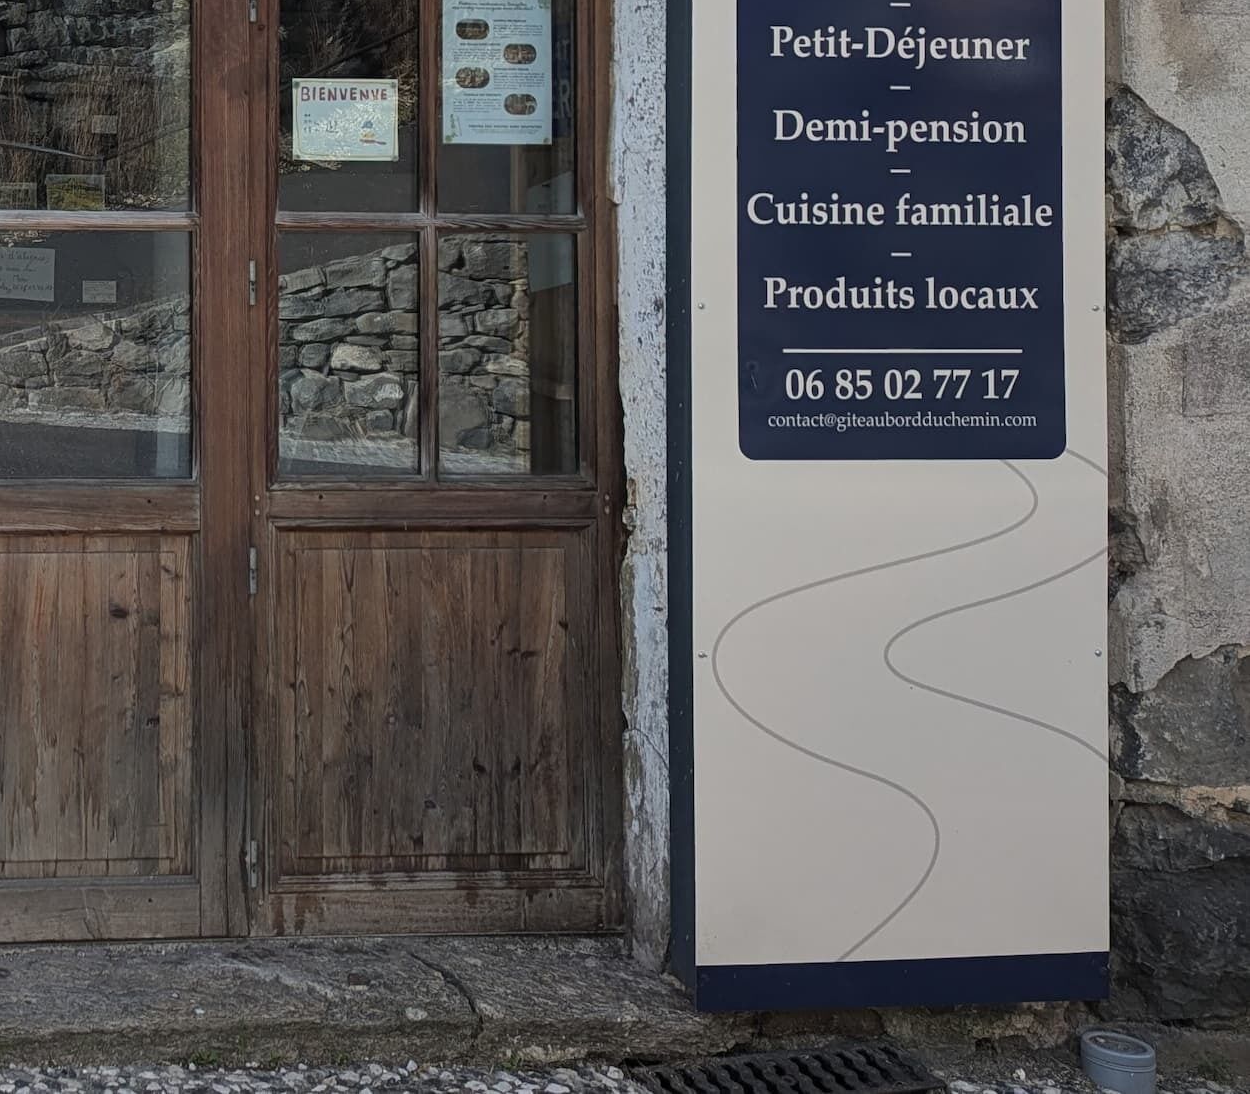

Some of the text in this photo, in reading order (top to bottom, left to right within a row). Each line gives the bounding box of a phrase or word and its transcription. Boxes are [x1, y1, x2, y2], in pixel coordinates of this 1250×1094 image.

[771, 26, 1030, 69] Petit-Déjeuner
[773, 110, 1027, 152] Demi-pension
[748, 193, 1053, 226] Cuisine familiale
[764, 277, 1039, 309] Produits locaux
[785, 369, 1020, 400] 06 85 02 77 17
[767, 411, 1037, 432] contact@giteaubordduchemin.com
